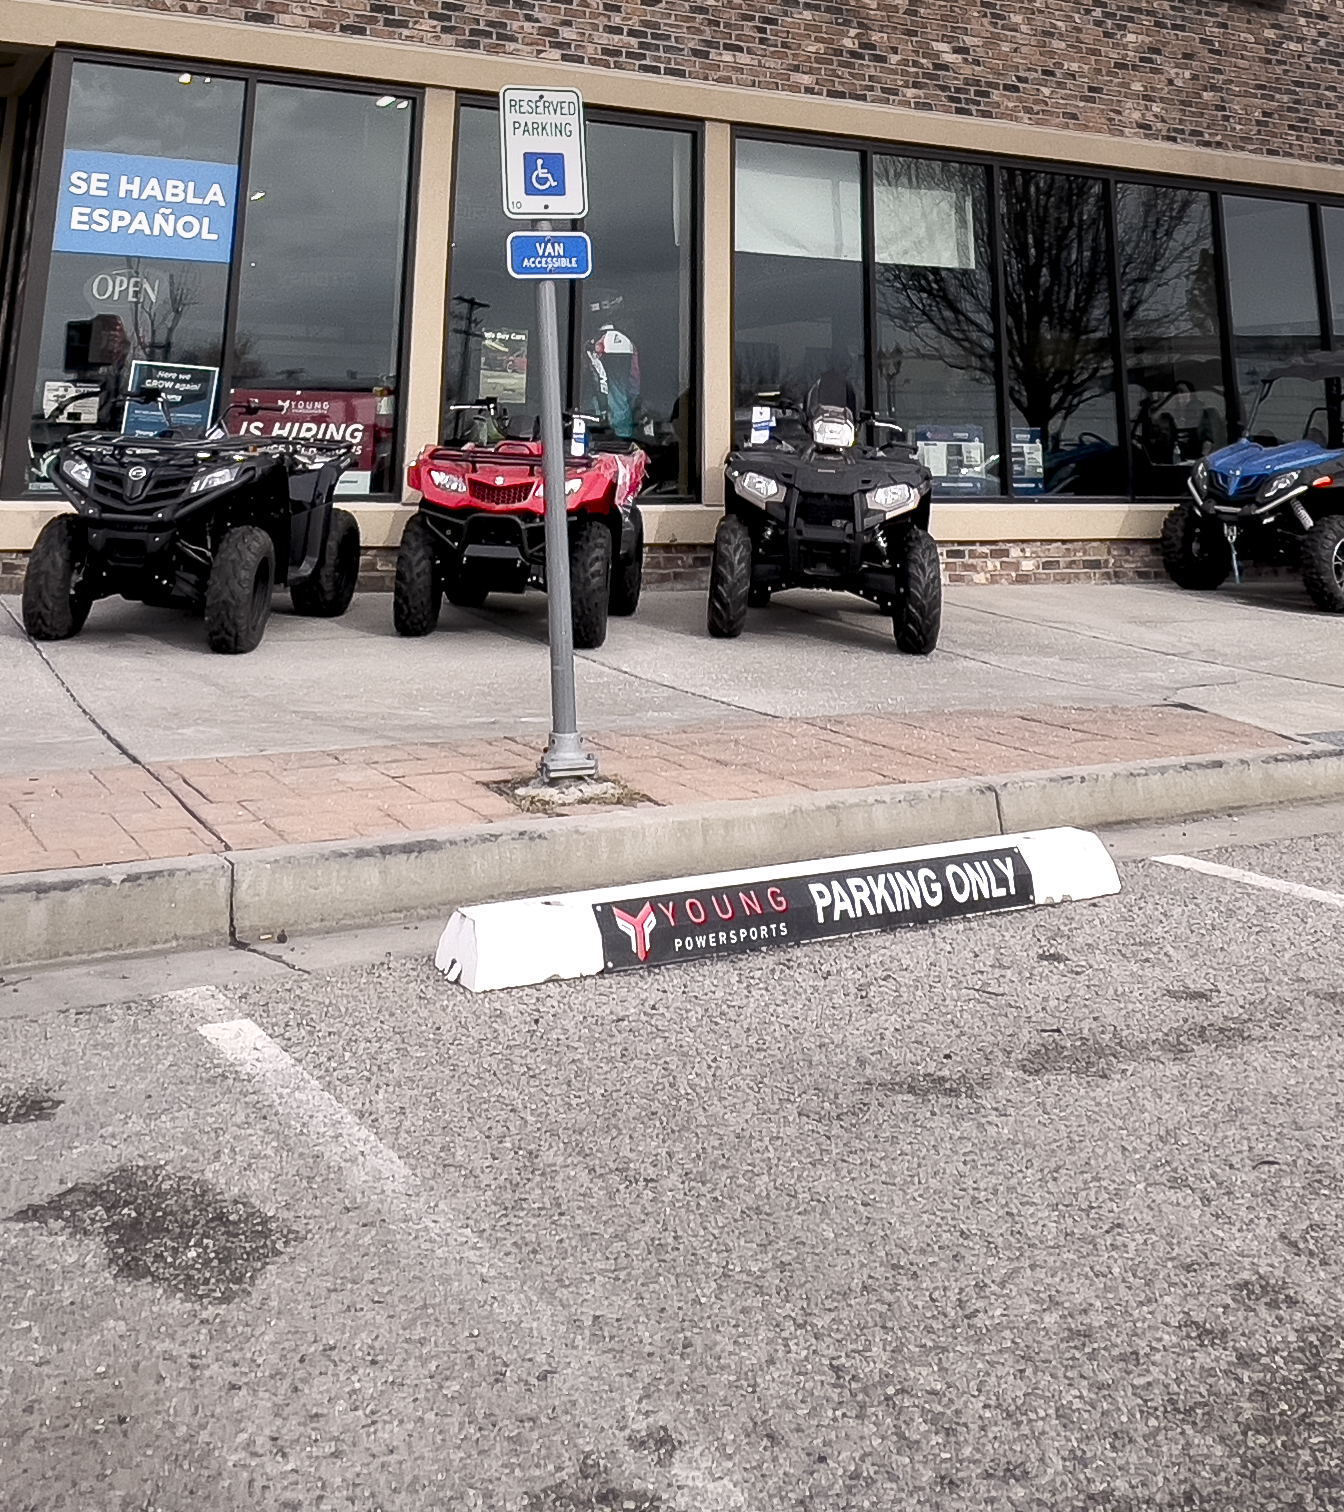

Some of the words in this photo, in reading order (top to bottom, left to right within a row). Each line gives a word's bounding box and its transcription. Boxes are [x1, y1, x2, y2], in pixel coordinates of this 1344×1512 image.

[509, 99, 576, 116] RESERVED
[513, 121, 572, 137] PARKING
[68, 171, 110, 197] SE
[118, 175, 226, 206] HABLA
[70, 206, 218, 240] ESPAÑOL
[536, 242, 564, 256] VAN
[522, 257, 577, 268] ACCESSIBLE
[92, 274, 159, 302] OPEN
[291, 400, 330, 411] YOUNG
[239, 421, 263, 436] IS
[272, 422, 364, 443] HIRING
[658, 886, 790, 928] YOUNG
[808, 867, 942, 924] PARKING
[946, 856, 1018, 903] ONLY
[674, 922, 788, 952] POWERSPORTS
